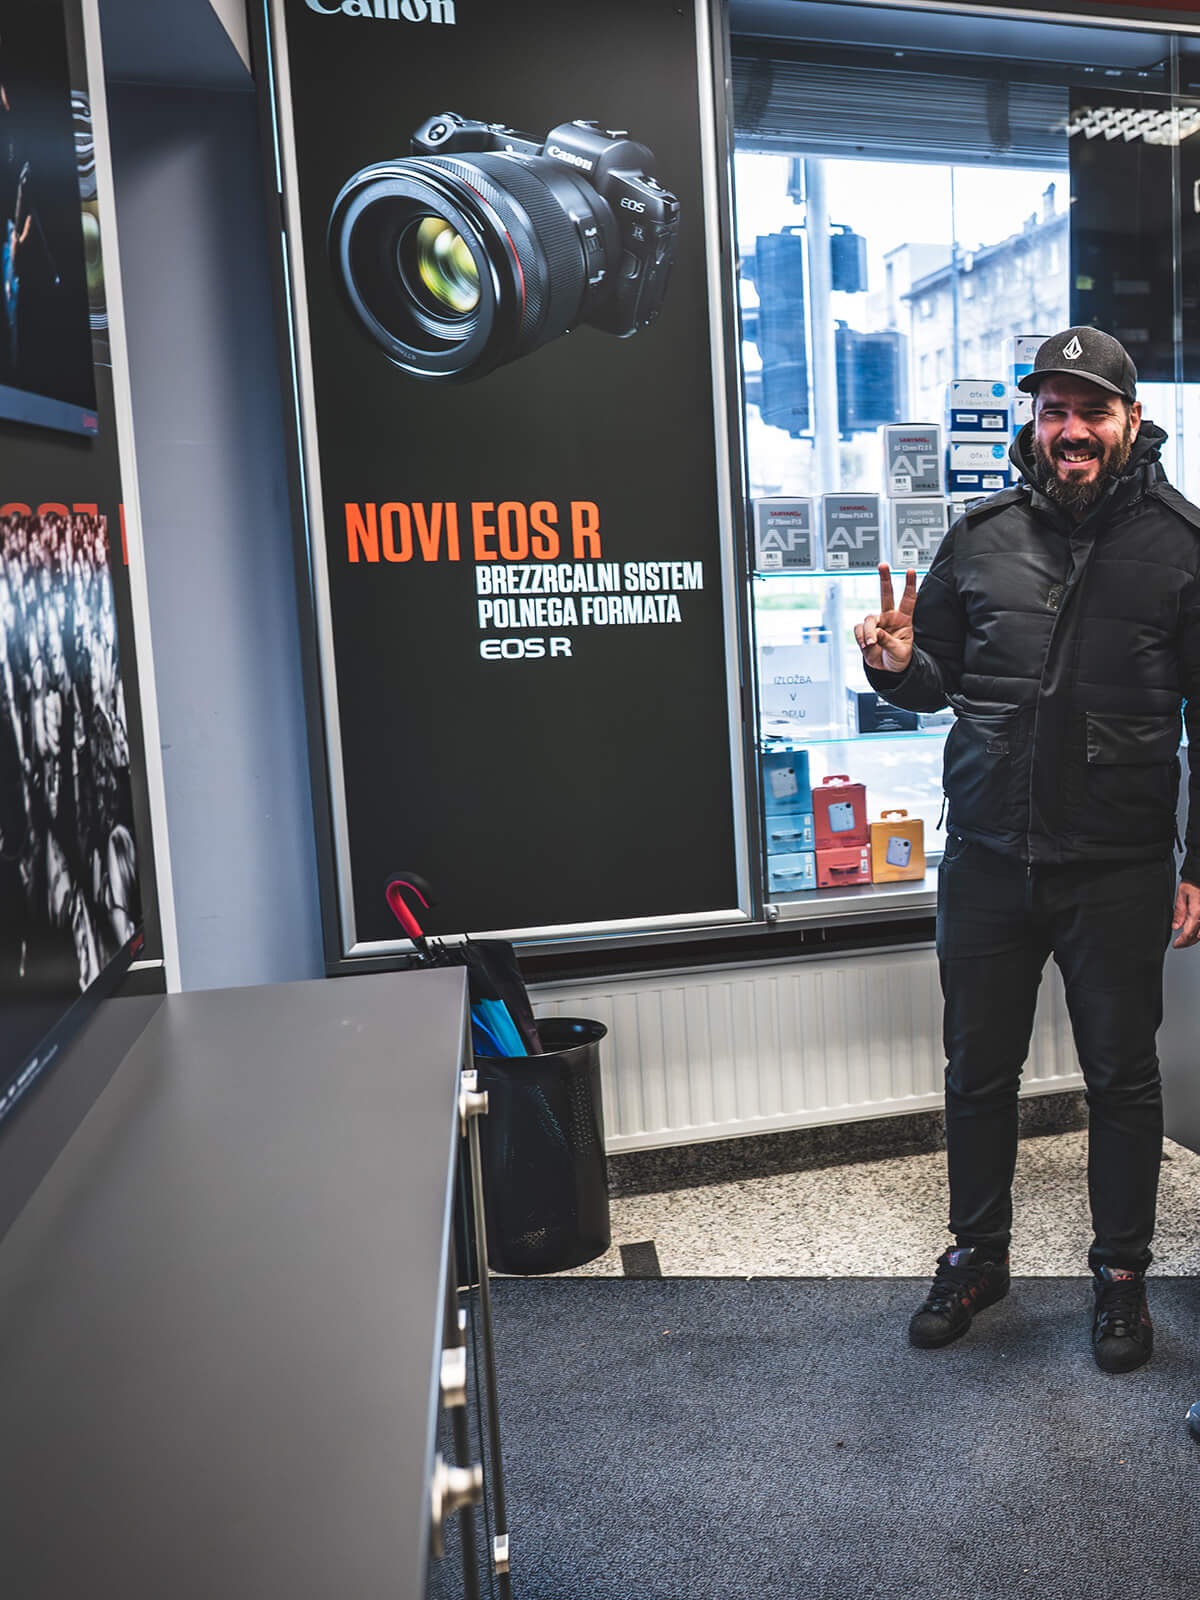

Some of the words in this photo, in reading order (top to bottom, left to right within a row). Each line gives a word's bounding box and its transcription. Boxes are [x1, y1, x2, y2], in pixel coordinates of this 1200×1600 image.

[547, 145, 593, 171] Canon
[620, 197, 646, 213] EOS
[632, 222, 644, 242] R
[890, 455, 939, 477] AF
[345, 502, 460, 563] NOVI
[471, 501, 560, 561] EOS
[570, 501, 602, 559] R
[760, 528, 810, 552] AF
[828, 526, 880, 549] AF
[898, 527, 945, 549] AF
[475, 563, 621, 595] BREZZRCALNI
[624, 561, 704, 591] SISTEM
[479, 597, 578, 628] POLNEGA
[582, 594, 682, 624] FORMATA
[480, 637, 546, 660] EOS
[550, 637, 573, 657] R
[774, 674, 813, 685] IZLOŽBA
[789, 692, 797, 702] V
